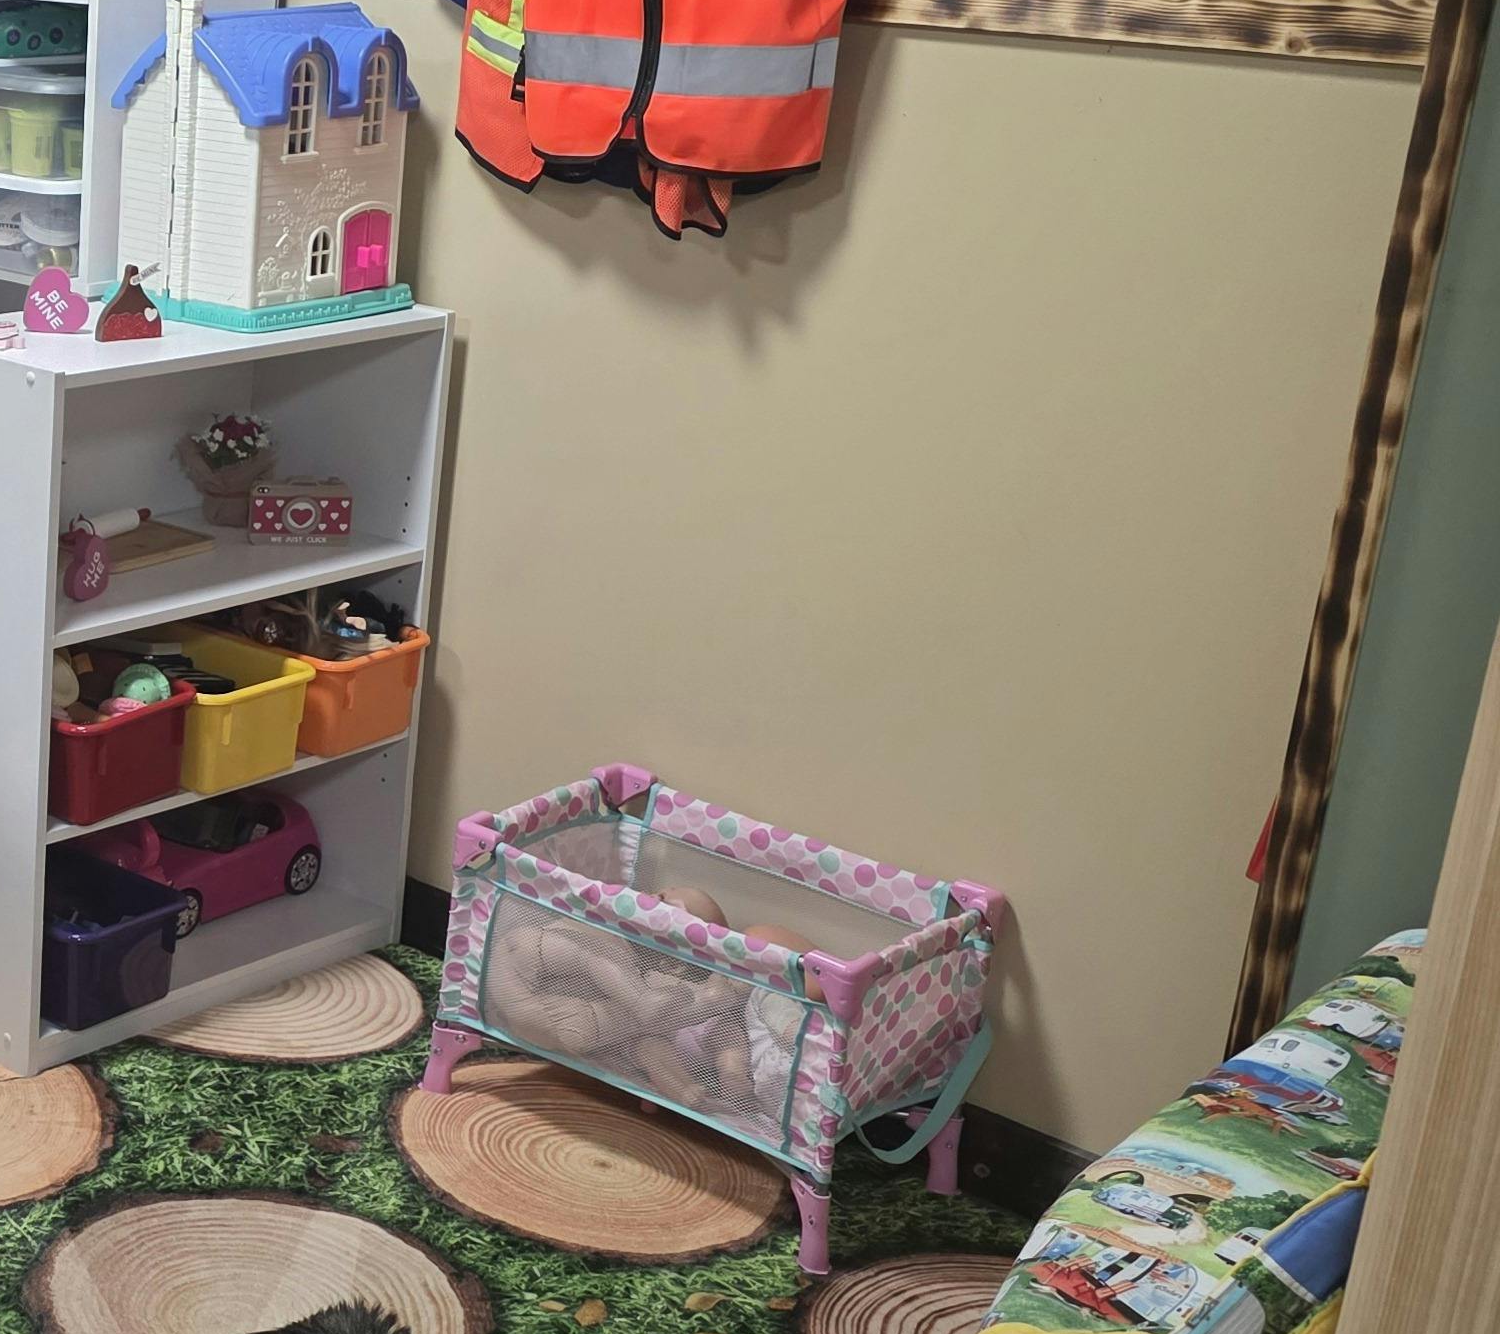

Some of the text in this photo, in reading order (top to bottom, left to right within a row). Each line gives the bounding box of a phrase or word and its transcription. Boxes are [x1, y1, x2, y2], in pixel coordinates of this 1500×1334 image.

[29, 290, 64, 331] MINE
[46, 289, 69, 314] BE
[285, 536, 303, 544] JUST
[306, 536, 327, 544] CLICK
[83, 551, 101, 588] HUG
[90, 560, 105, 588] ME
